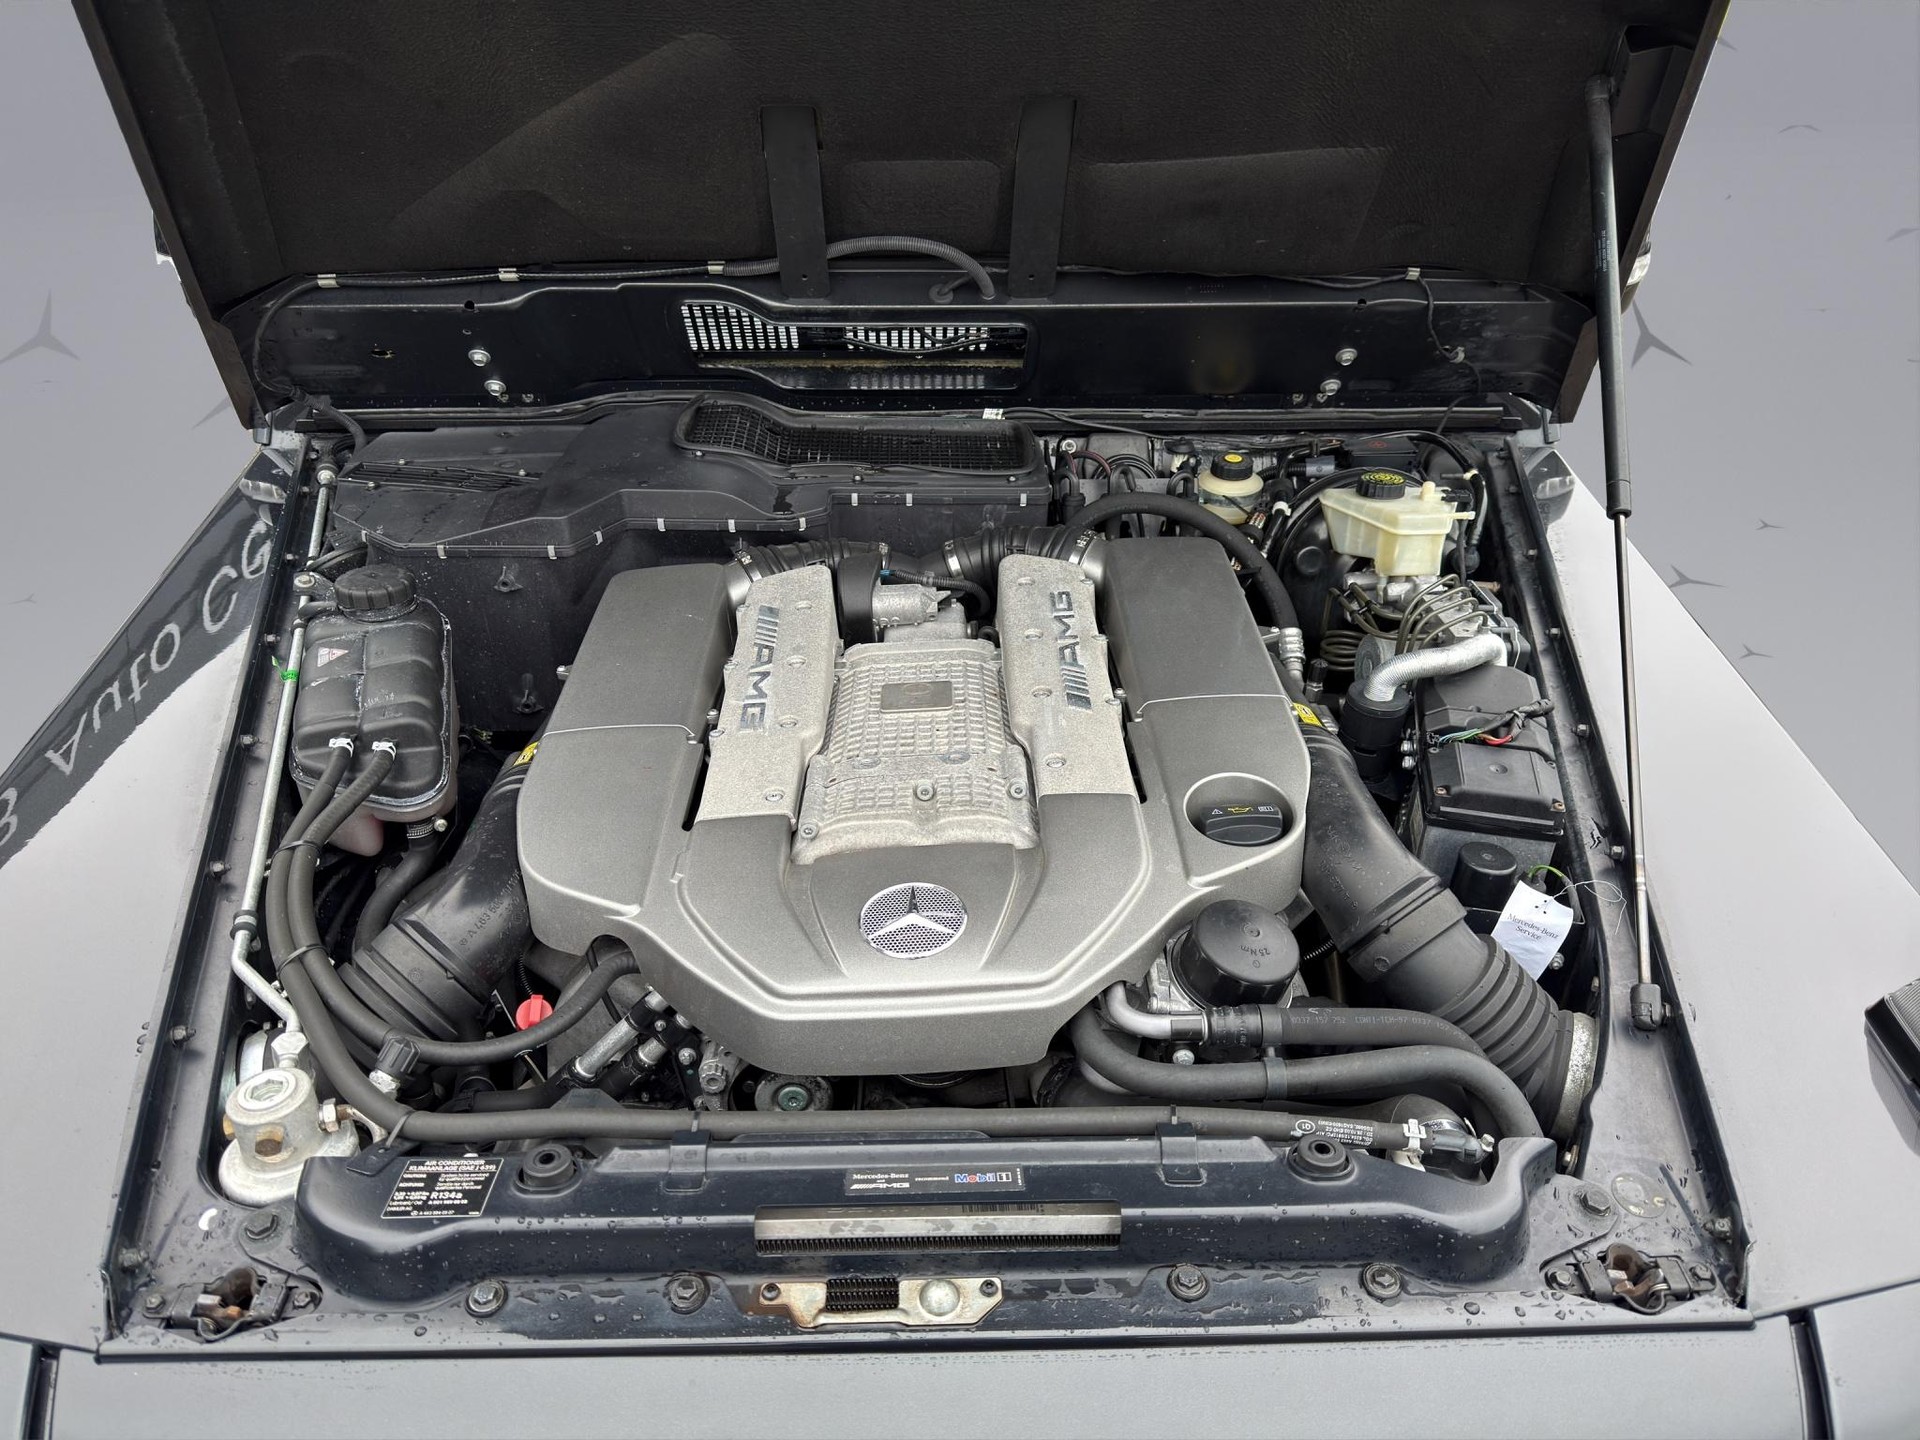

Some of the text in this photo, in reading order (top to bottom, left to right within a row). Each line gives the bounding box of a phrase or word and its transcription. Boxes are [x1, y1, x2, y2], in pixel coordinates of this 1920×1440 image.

[1050, 590, 1083, 670] AMG
[740, 640, 776, 732] AMG
[1507, 913, 1559, 939] Mercedes-Benz
[1515, 926, 1542, 941] Service
[954, 1172, 996, 1184] Mobil
